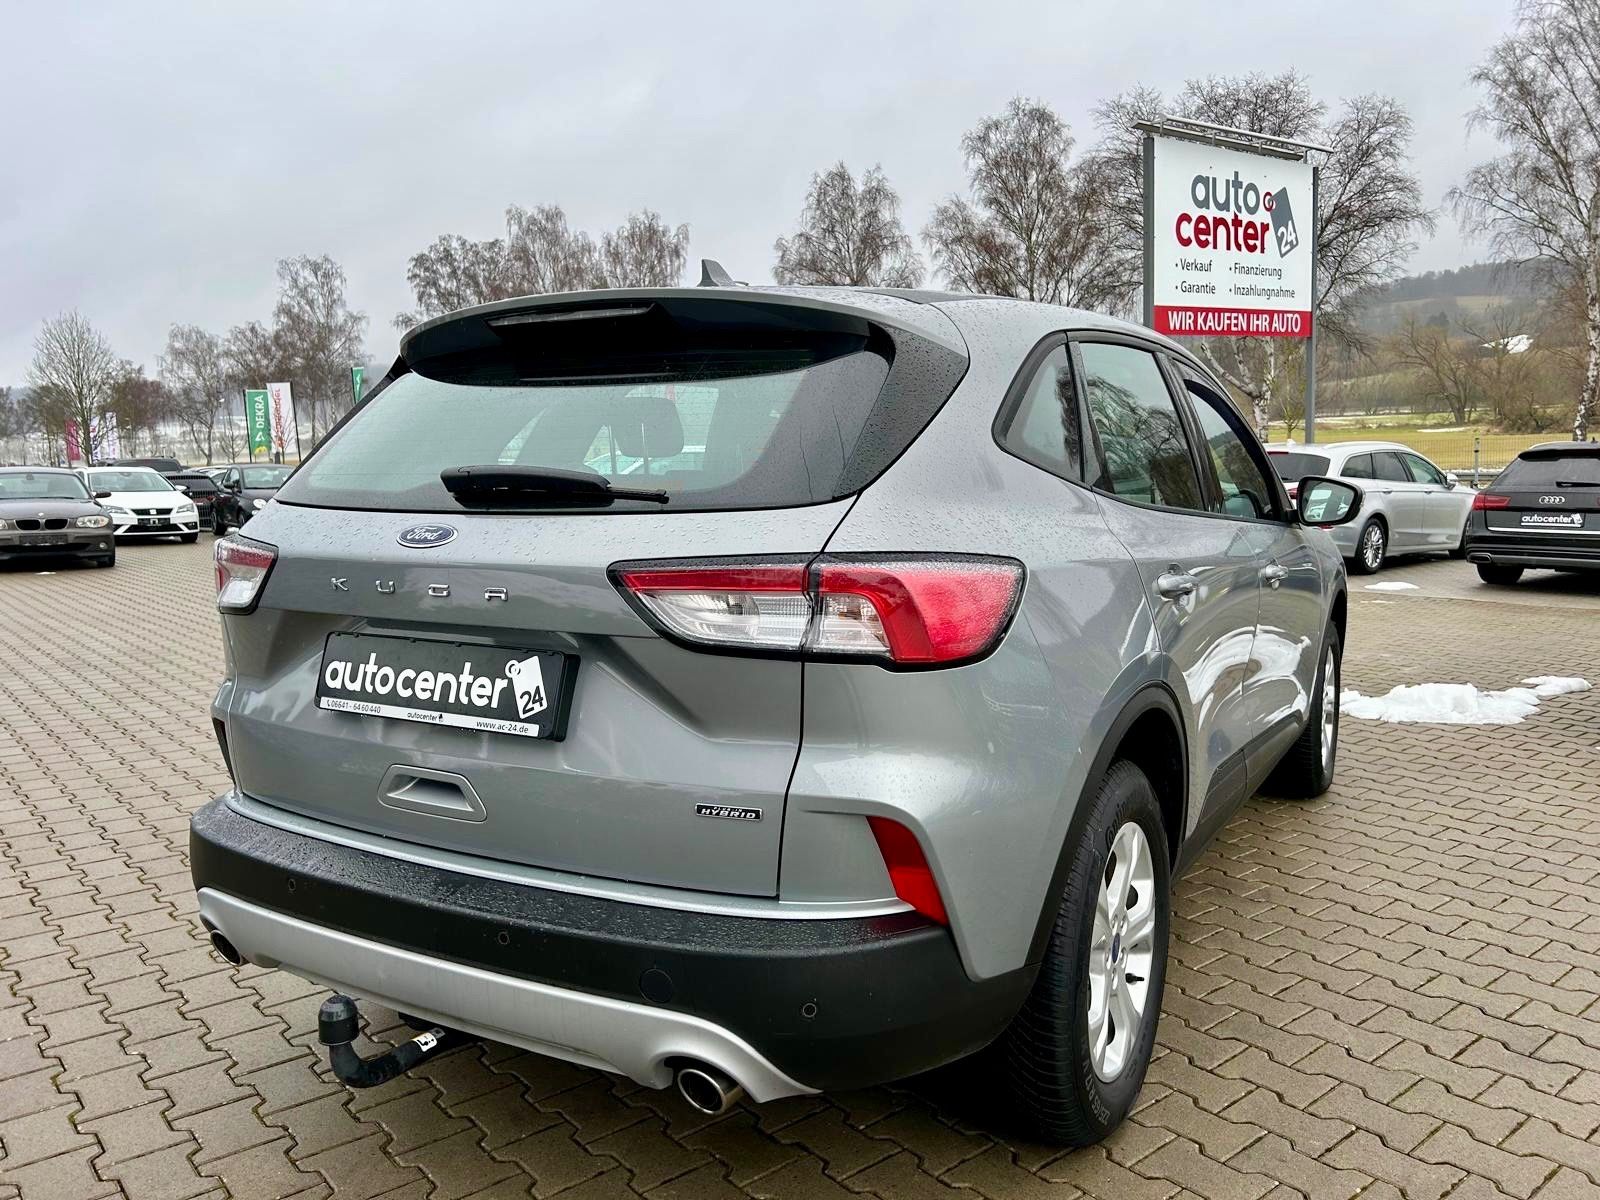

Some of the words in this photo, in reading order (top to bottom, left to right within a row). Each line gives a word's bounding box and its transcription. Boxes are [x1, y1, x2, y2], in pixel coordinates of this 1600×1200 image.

[1191, 171, 1260, 215] auto
[1175, 213, 1269, 253] center
[1278, 221, 1297, 252] 24
[1180, 259, 1212, 272] Verkauf
[1234, 263, 1282, 280] Finanzierung
[1180, 281, 1216, 294] Garantie
[1234, 284, 1295, 300] Inzahlungnahme
[1168, 311, 1194, 331] WIR
[1197, 312, 1247, 332] KAUFEN
[1249, 314, 1270, 332] IHR
[1272, 314, 1300, 333] AUTO
[254, 394, 264, 428] DEKRA
[1522, 514, 1572, 523] autocenter
[406, 526, 443, 540] Ford
[331, 577, 508, 601] KUGA
[325, 653, 508, 708] autocenter
[520, 686, 544, 714] 24
[407, 712, 438, 721] autocenter
[476, 720, 528, 734] www.ac-24.de
[701, 808, 756, 818] HYBRID
